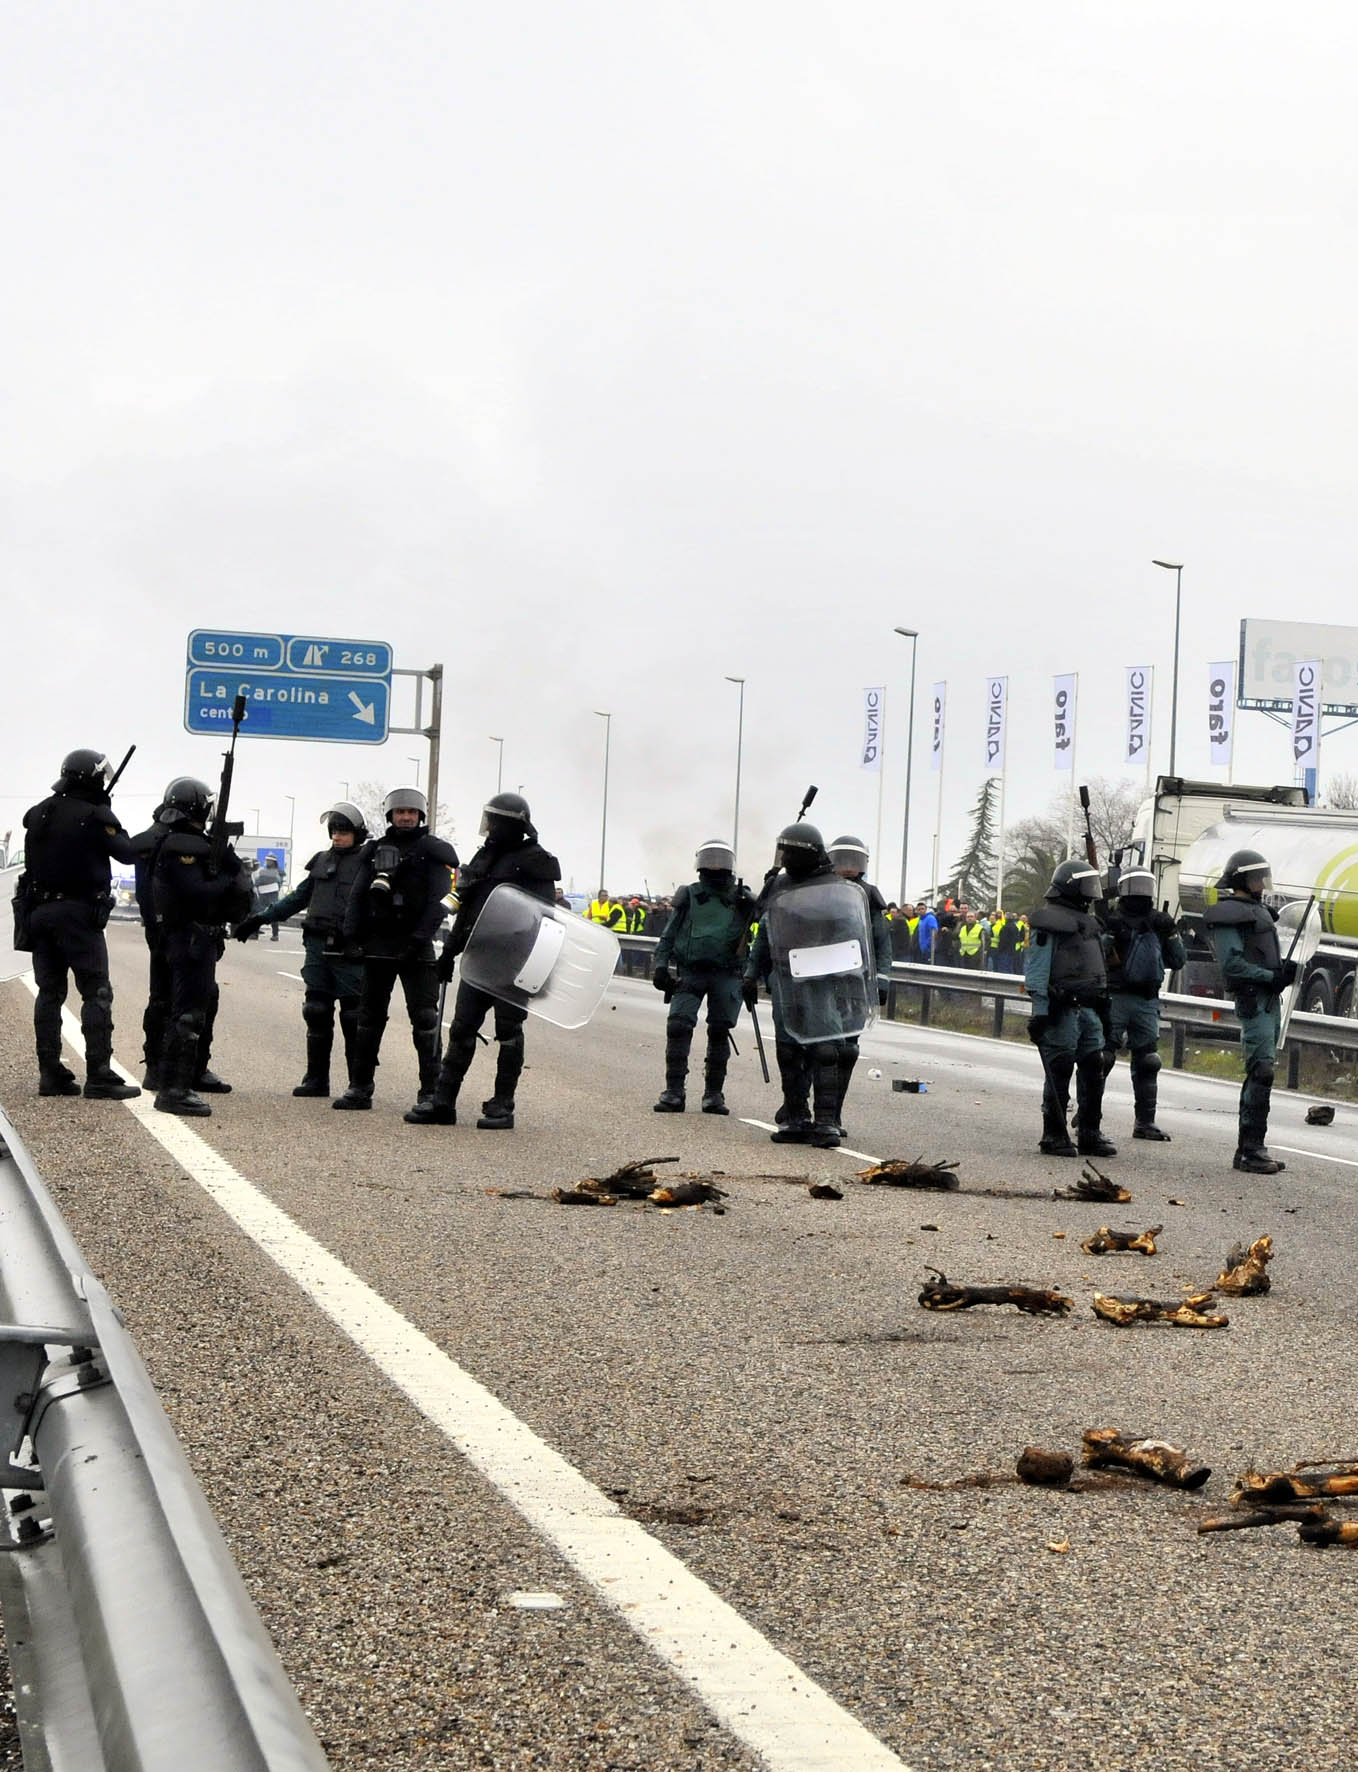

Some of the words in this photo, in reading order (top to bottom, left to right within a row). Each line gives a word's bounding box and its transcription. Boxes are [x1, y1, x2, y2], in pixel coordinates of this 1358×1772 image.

[204, 641, 244, 657] 500
[253, 646, 269, 659] m
[340, 651, 377, 666] 268
[199, 681, 227, 699] La
[237, 683, 330, 705] Carolina
